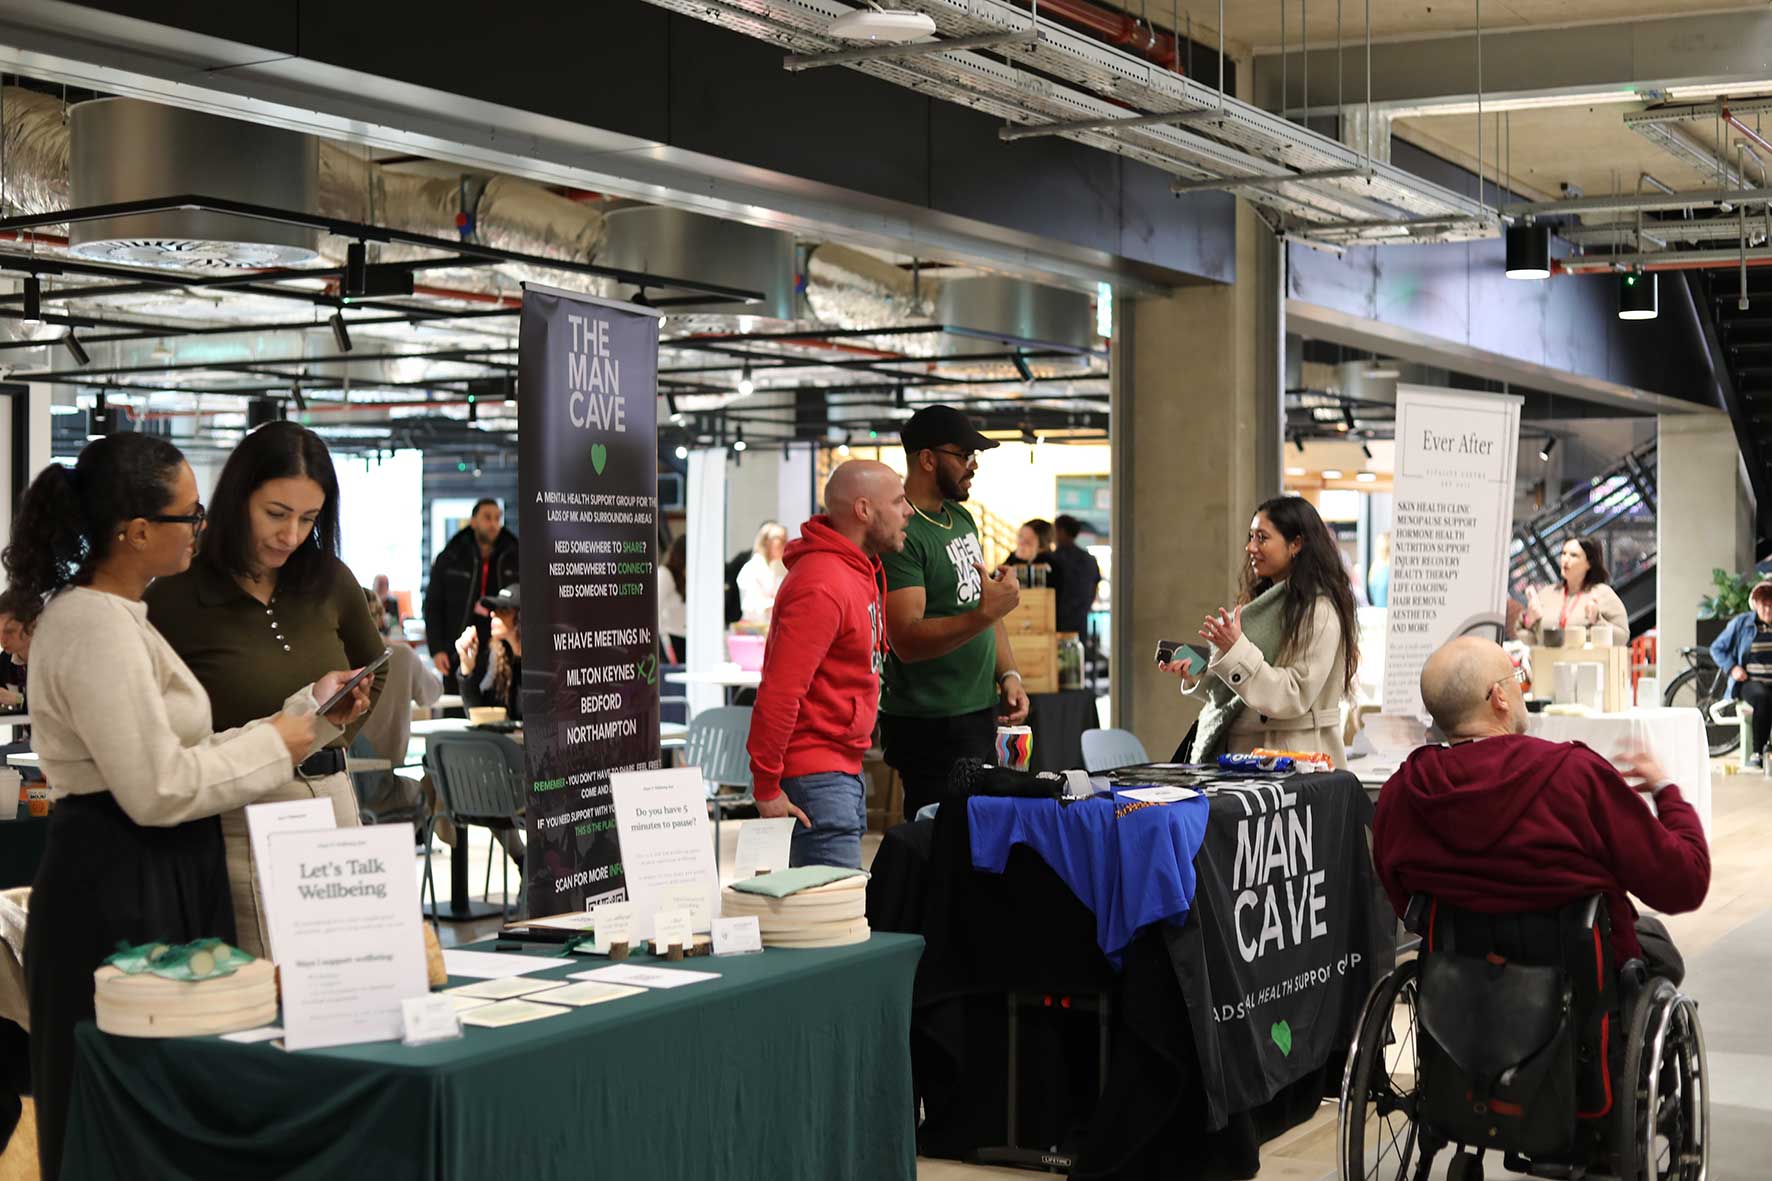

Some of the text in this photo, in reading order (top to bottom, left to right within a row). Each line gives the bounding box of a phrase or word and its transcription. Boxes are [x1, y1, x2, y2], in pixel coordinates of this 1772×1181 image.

[568, 314, 610, 358] THE
[568, 352, 619, 395] MAN
[569, 391, 626, 432] CAVE
[1423, 430, 1494, 455] Ever After
[535, 491, 543, 503] A
[544, 491, 567, 503] MENTAL
[567, 493, 590, 505] HEALTH
[590, 494, 616, 506] SUPPORT
[616, 496, 636, 507] GROUP
[636, 497, 648, 507] FOR
[1398, 502, 1416, 512] SKIN
[1417, 502, 1446, 513] HEALTH
[547, 510, 652, 524] LADS OF MK AND SURROUNDING AREAS
[1397, 515, 1478, 528] MENOPAUSE SUPPORT
[1396, 528, 1465, 540] HORMONE HEALTH
[554, 541, 647, 554] NEED SOMEWHERE TO SHARE?
[1395, 542, 1470, 554] NUTRITION SUPPORT
[549, 562, 652, 576] NEED SOMEWHERE TO CONNECT?
[1394, 556, 1460, 567] INJURY RECOVERY
[1394, 569, 1458, 580] BEAUTY THERAPY
[559, 583, 644, 598] NEED SOMEONE TO LISTEN?
[1393, 583, 1448, 593] LIFE COACHING
[1392, 596, 1447, 606] HAIR REMOVAL
[1392, 609, 1437, 620] AESTHETICS
[1391, 623, 1429, 633] AND MORE
[553, 627, 651, 651] WE HAVE MEETINGS IN:
[567, 663, 635, 687] MILTON KEYNES
[581, 693, 622, 714] BEDFORD
[567, 718, 637, 745] NORTHAMPTON
[534, 777, 566, 792] REMEMBER
[568, 775, 580, 787] YOU
[580, 771, 596, 784] DON'T
[597, 769, 611, 780] HAVE
[581, 785, 609, 799] COME AND
[537, 818, 545, 830] IF
[545, 816, 559, 829] YOU
[559, 813, 570, 825] NEED
[570, 807, 594, 822] SUPPORT
[594, 804, 608, 818] WITH
[636, 804, 689, 818] Do you have 5
[575, 825, 586, 837] THIS
[587, 824, 592, 835] IS
[592, 823, 601, 833] THE
[631, 817, 697, 832] minutes to pause?
[1233, 804, 1313, 891] MAN
[300, 858, 386, 880] Let's Talk
[555, 873, 573, 893] SCAN
[573, 870, 588, 888] FOR
[588, 865, 609, 884] MORE
[298, 881, 388, 901] Wellbeing
[1234, 869, 1328, 963] CAVE
[1258, 978, 1293, 1005] HEALTH
